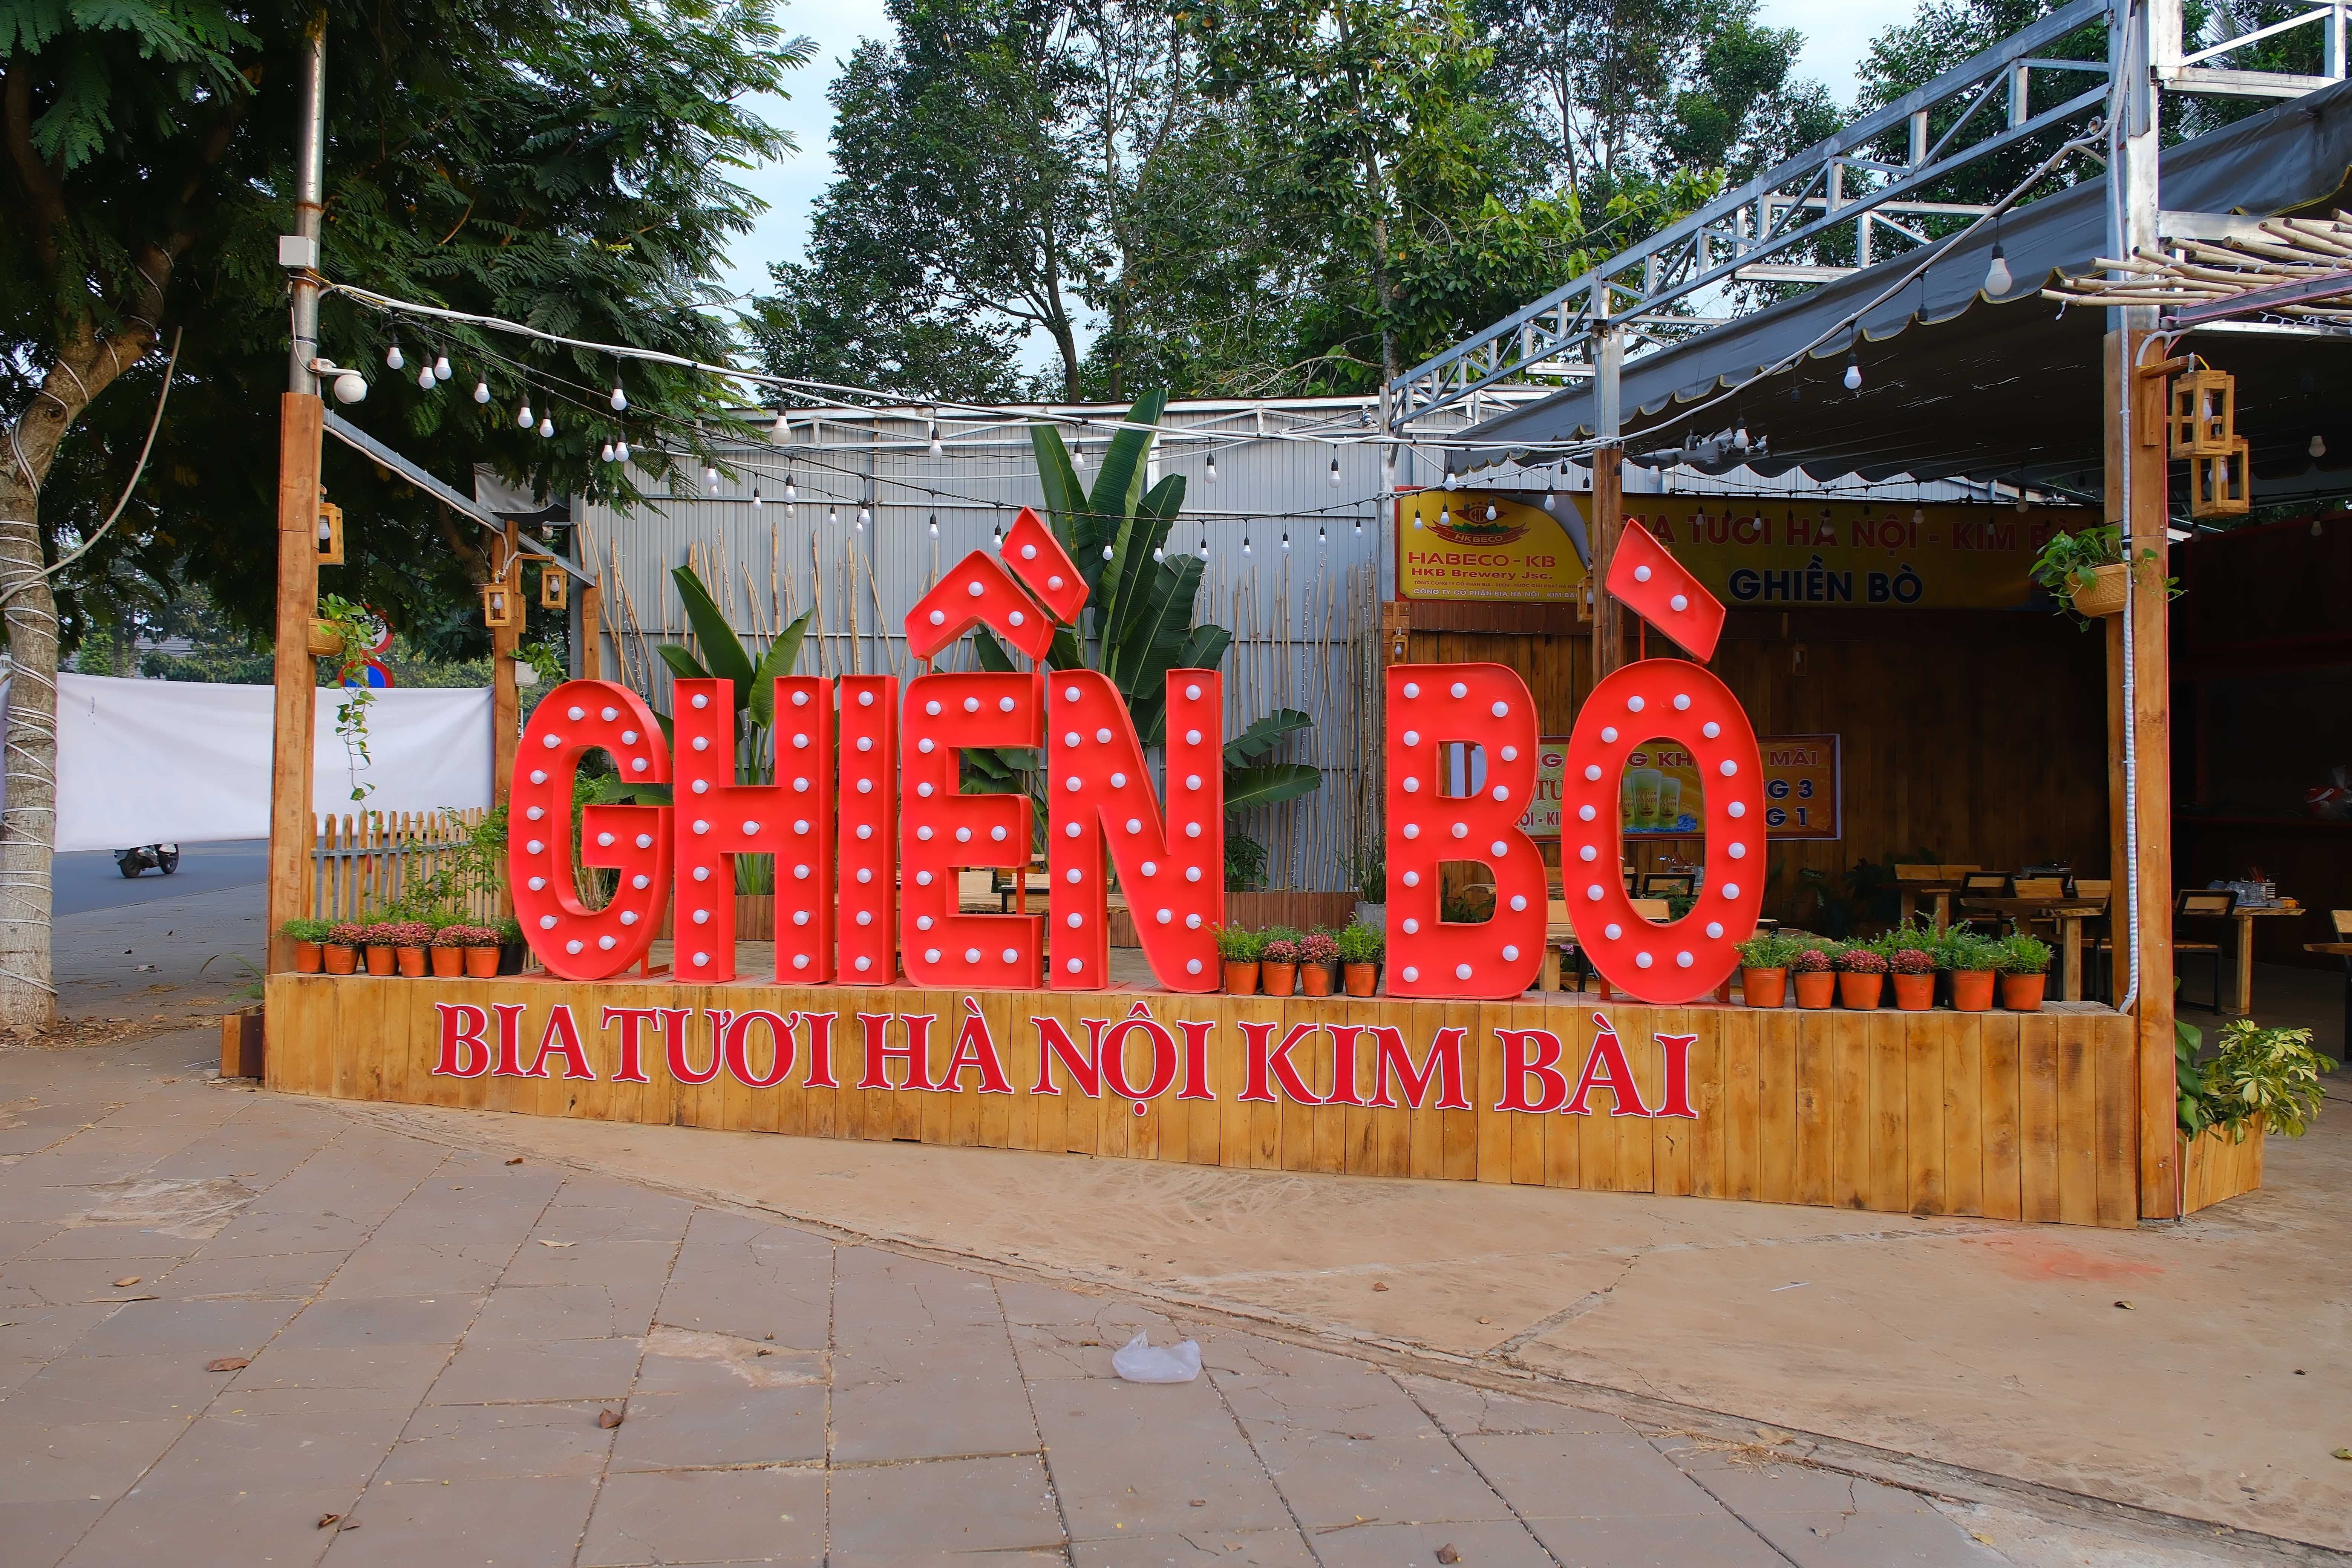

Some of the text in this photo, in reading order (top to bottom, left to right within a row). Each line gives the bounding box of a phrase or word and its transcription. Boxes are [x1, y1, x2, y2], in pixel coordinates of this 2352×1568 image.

[1455, 534, 1503, 543] HKBECO
[1851, 513, 1917, 556] NỘI
[1952, 522, 2016, 551] KIM
[1412, 568, 1446, 577] HKB
[1452, 569, 1516, 580] Brewery
[1727, 554, 1923, 603] GHIỀN BÒ
[509, 507, 1766, 1005] GHIỀN BÒ
[1769, 747, 1818, 766] MÃI
[1798, 779, 1814, 799] 3
[1796, 807, 1807, 826] 1
[432, 996, 1699, 1119] BIA TƯƠI HÀ NỘI KIM BÀI
